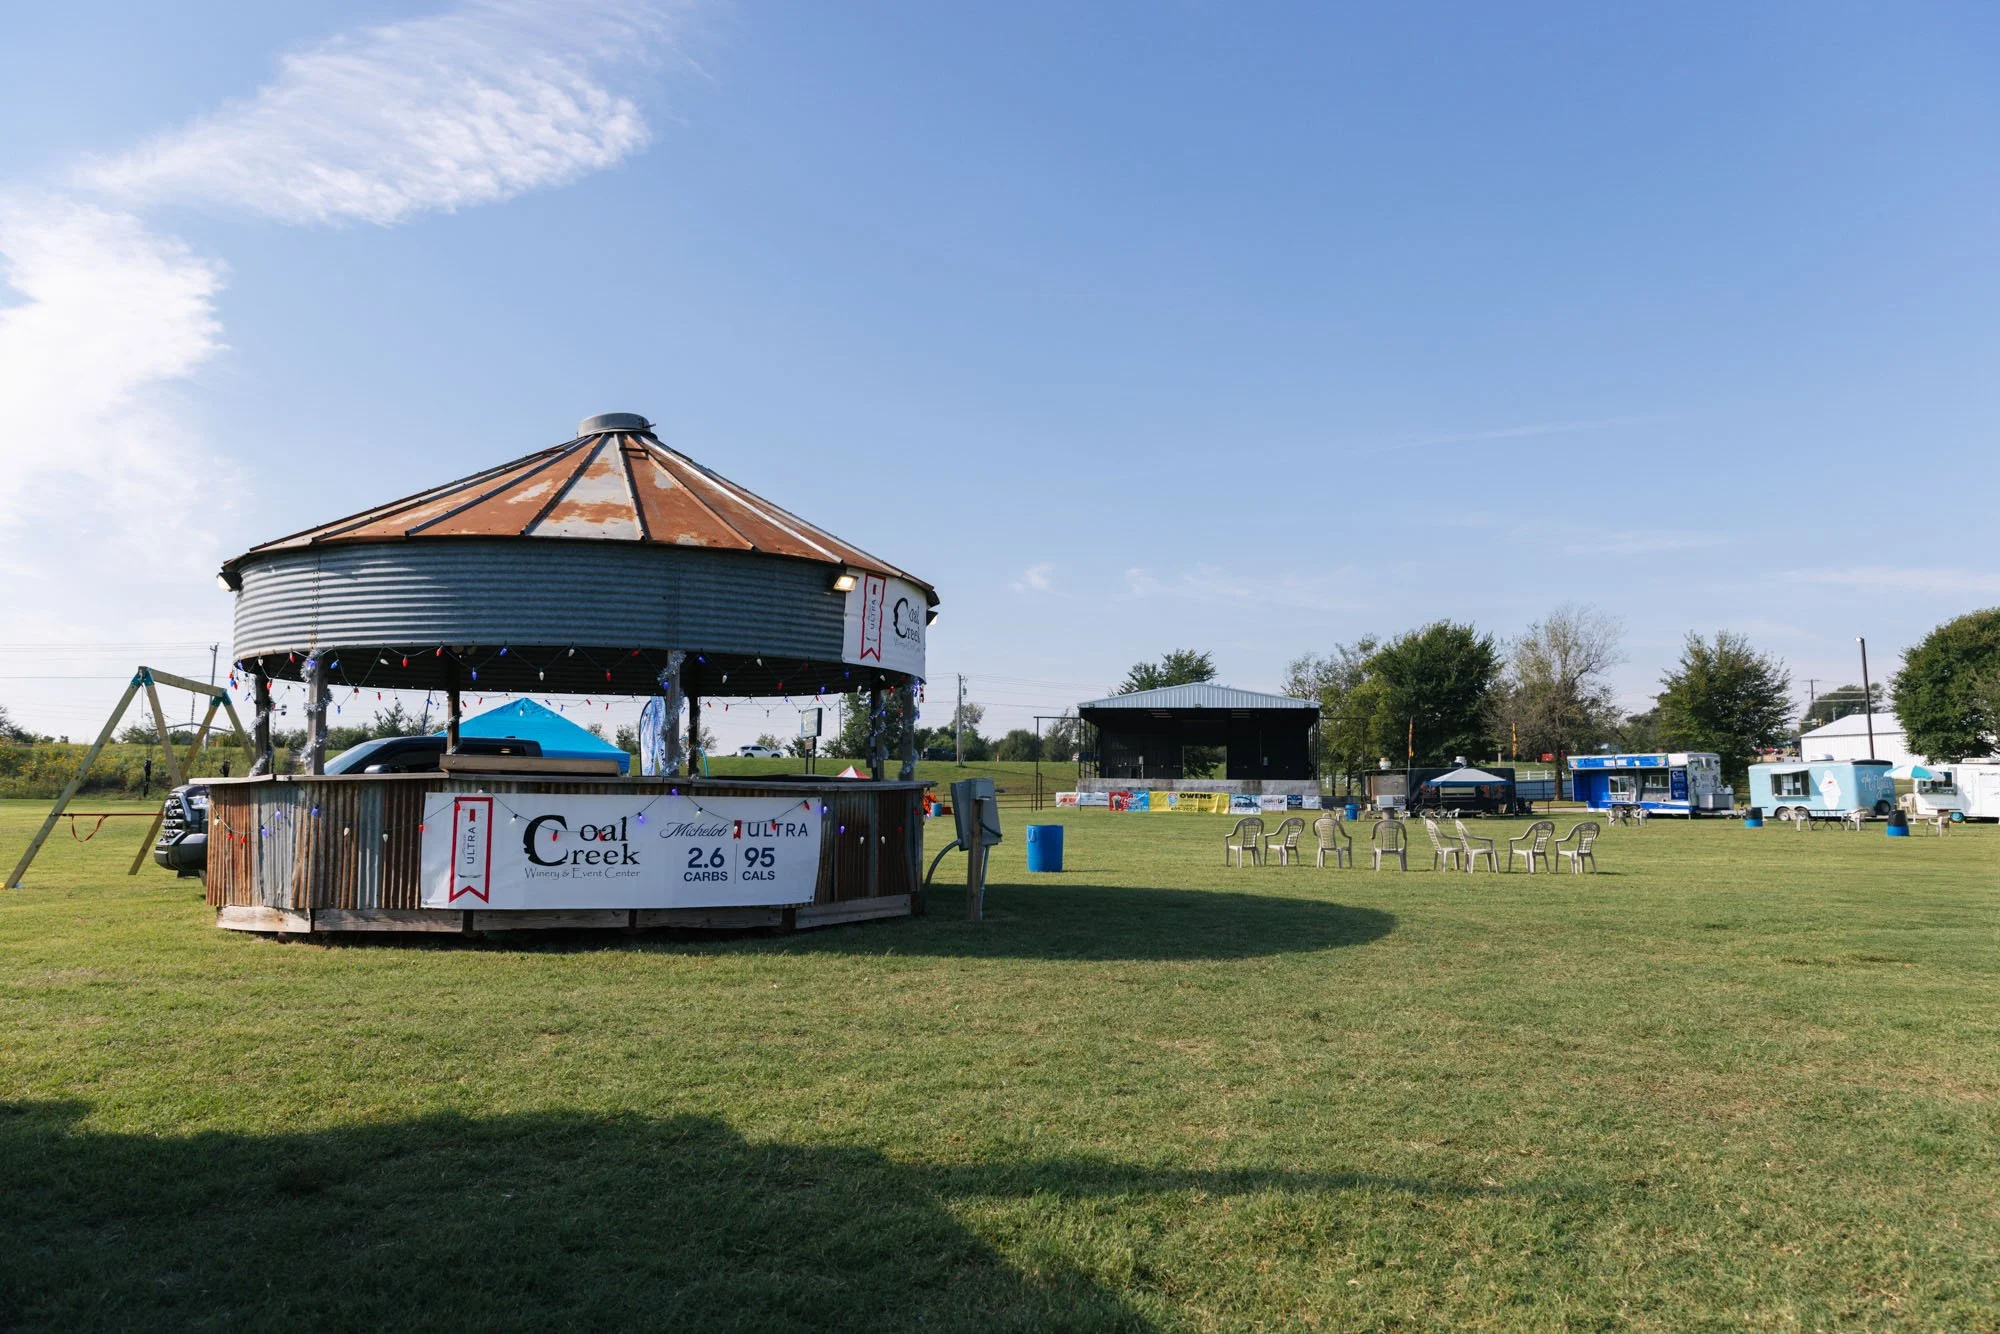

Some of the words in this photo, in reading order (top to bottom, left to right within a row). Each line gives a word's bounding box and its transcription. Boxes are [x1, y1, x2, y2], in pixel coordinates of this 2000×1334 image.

[659, 821, 728, 839] Michelob
[747, 822, 808, 837] ULTRA
[467, 826, 476, 864] ULTRA
[687, 847, 725, 869] 2.6
[744, 847, 775, 868] 95
[524, 867, 560, 880] Winery
[572, 867, 602, 879] Event
[604, 867, 640, 879] Center
[683, 870, 728, 882] CARBS
[742, 870, 775, 881] CALS
